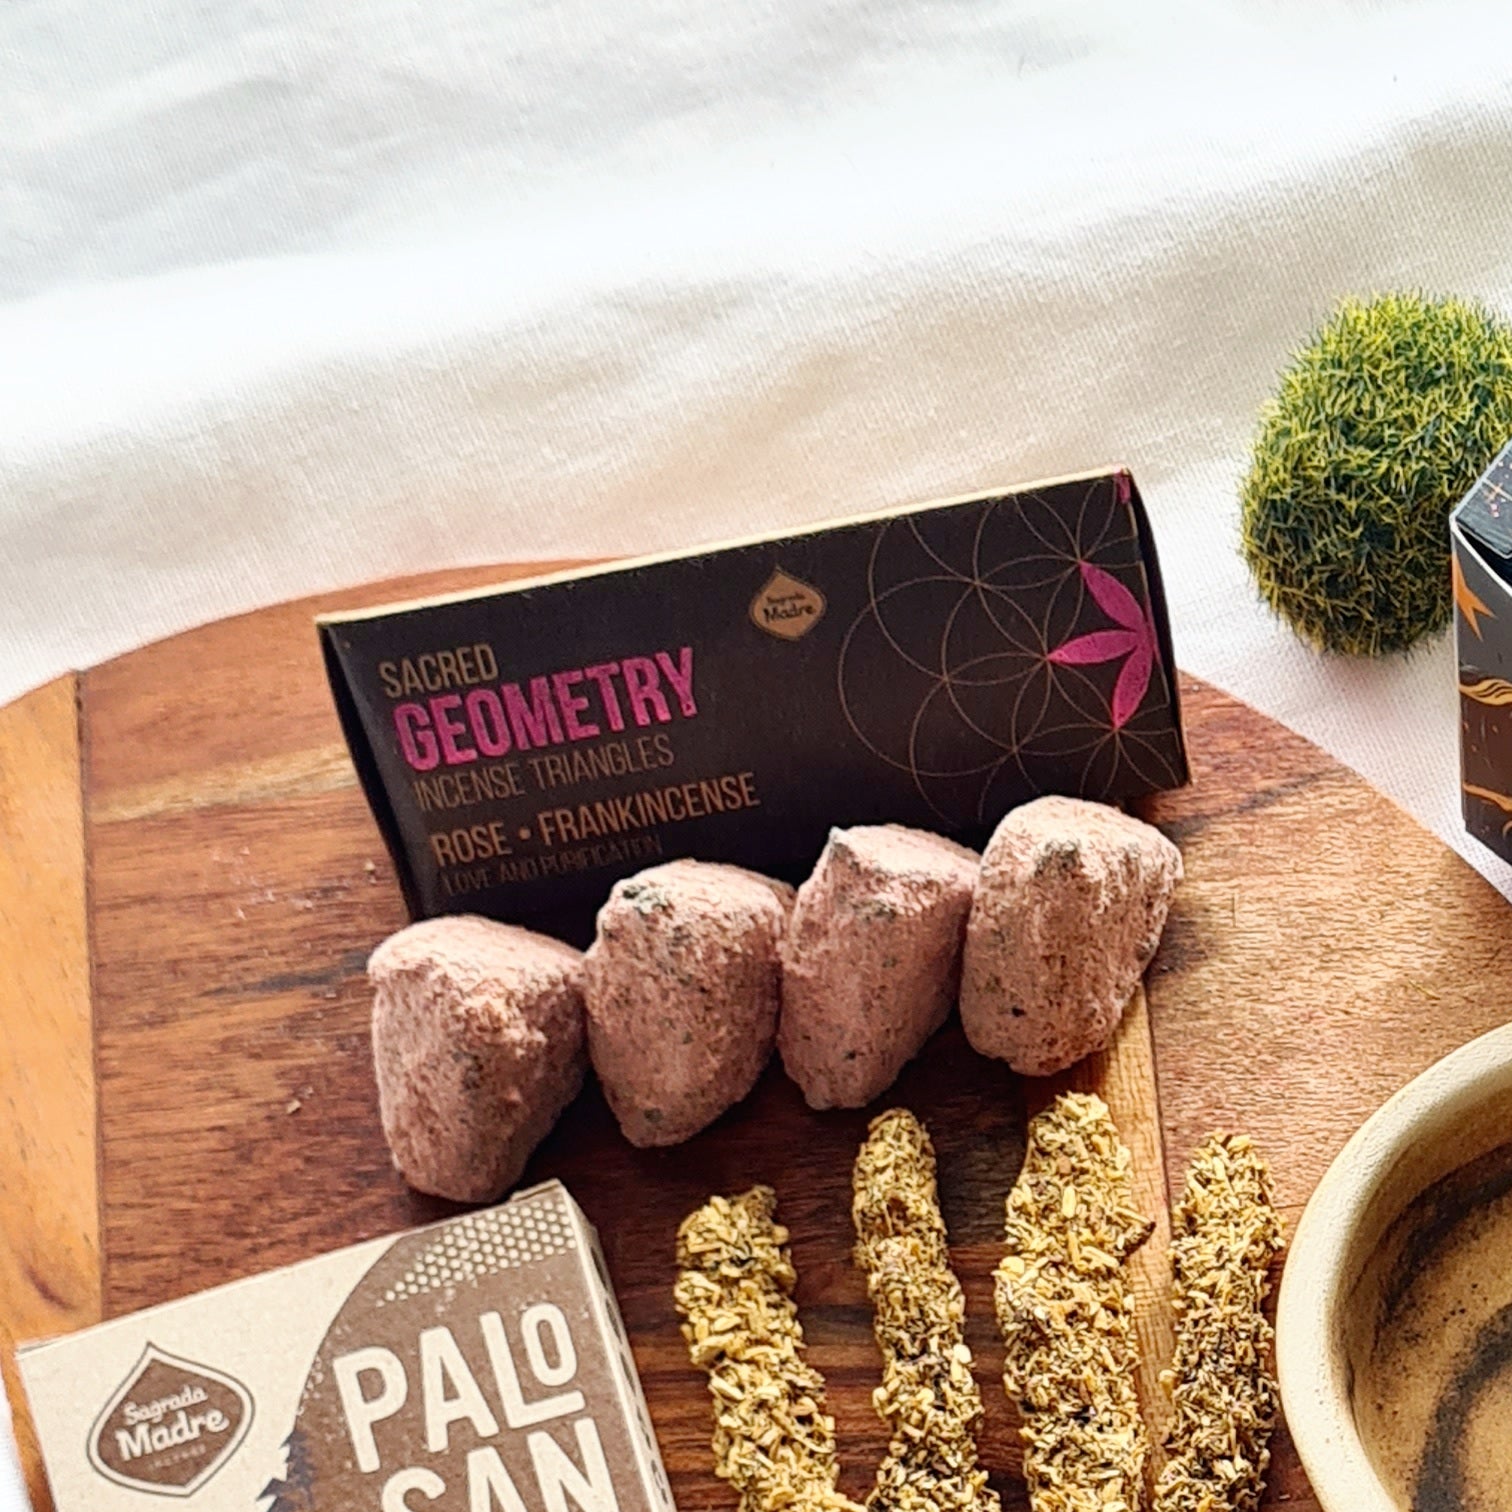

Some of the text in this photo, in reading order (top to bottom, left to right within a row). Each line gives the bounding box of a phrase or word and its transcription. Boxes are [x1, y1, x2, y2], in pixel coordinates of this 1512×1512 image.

[379, 642, 500, 699] SACRED
[393, 645, 698, 773] GEOMETRY
[411, 733, 675, 813] INCENSE TRIANGLES
[429, 771, 762, 867] ROSE FRANKINCENSE
[439, 868, 492, 897] LOVE
[123, 1383, 209, 1426] Sagrada
[332, 1303, 586, 1474] PALO
[114, 1408, 230, 1462] Madre
